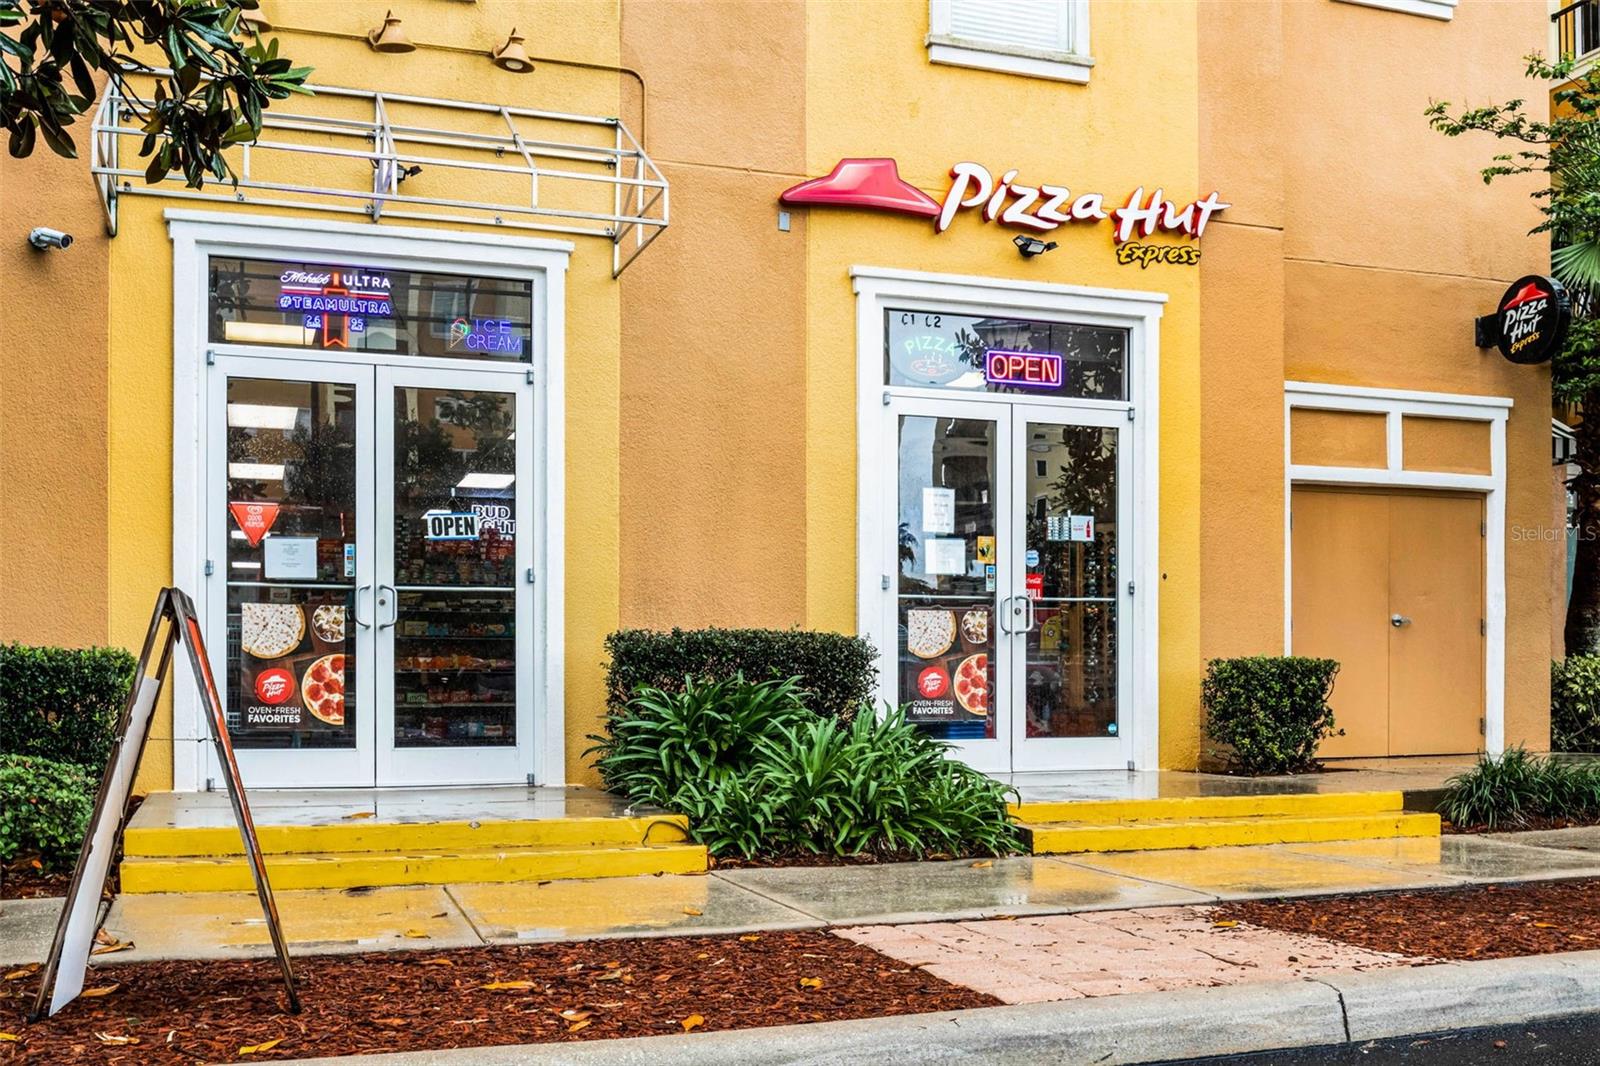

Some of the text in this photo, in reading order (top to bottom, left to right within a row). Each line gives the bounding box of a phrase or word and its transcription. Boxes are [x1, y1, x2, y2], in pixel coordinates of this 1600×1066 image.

[935, 161, 1232, 244] Pizza Hut
[1117, 242, 1200, 268] Express
[280, 271, 391, 288] Michelob ULTRA
[280, 296, 391, 314] #TEAMULTRA
[475, 319, 512, 334] ICE
[1503, 299, 1548, 335] Pizza
[1510, 314, 1543, 344] Hut
[466, 334, 522, 353] CREAM
[904, 335, 957, 357] PIZZA
[1510, 331, 1541, 354] Express
[990, 354, 1058, 383] OPEN
[471, 504, 511, 520] BUD
[431, 516, 476, 537] OPEN
[248, 706, 301, 714] OVEN-FRESH
[248, 714, 301, 724] FAVORITES
[912, 706, 954, 715] FAVORITES
